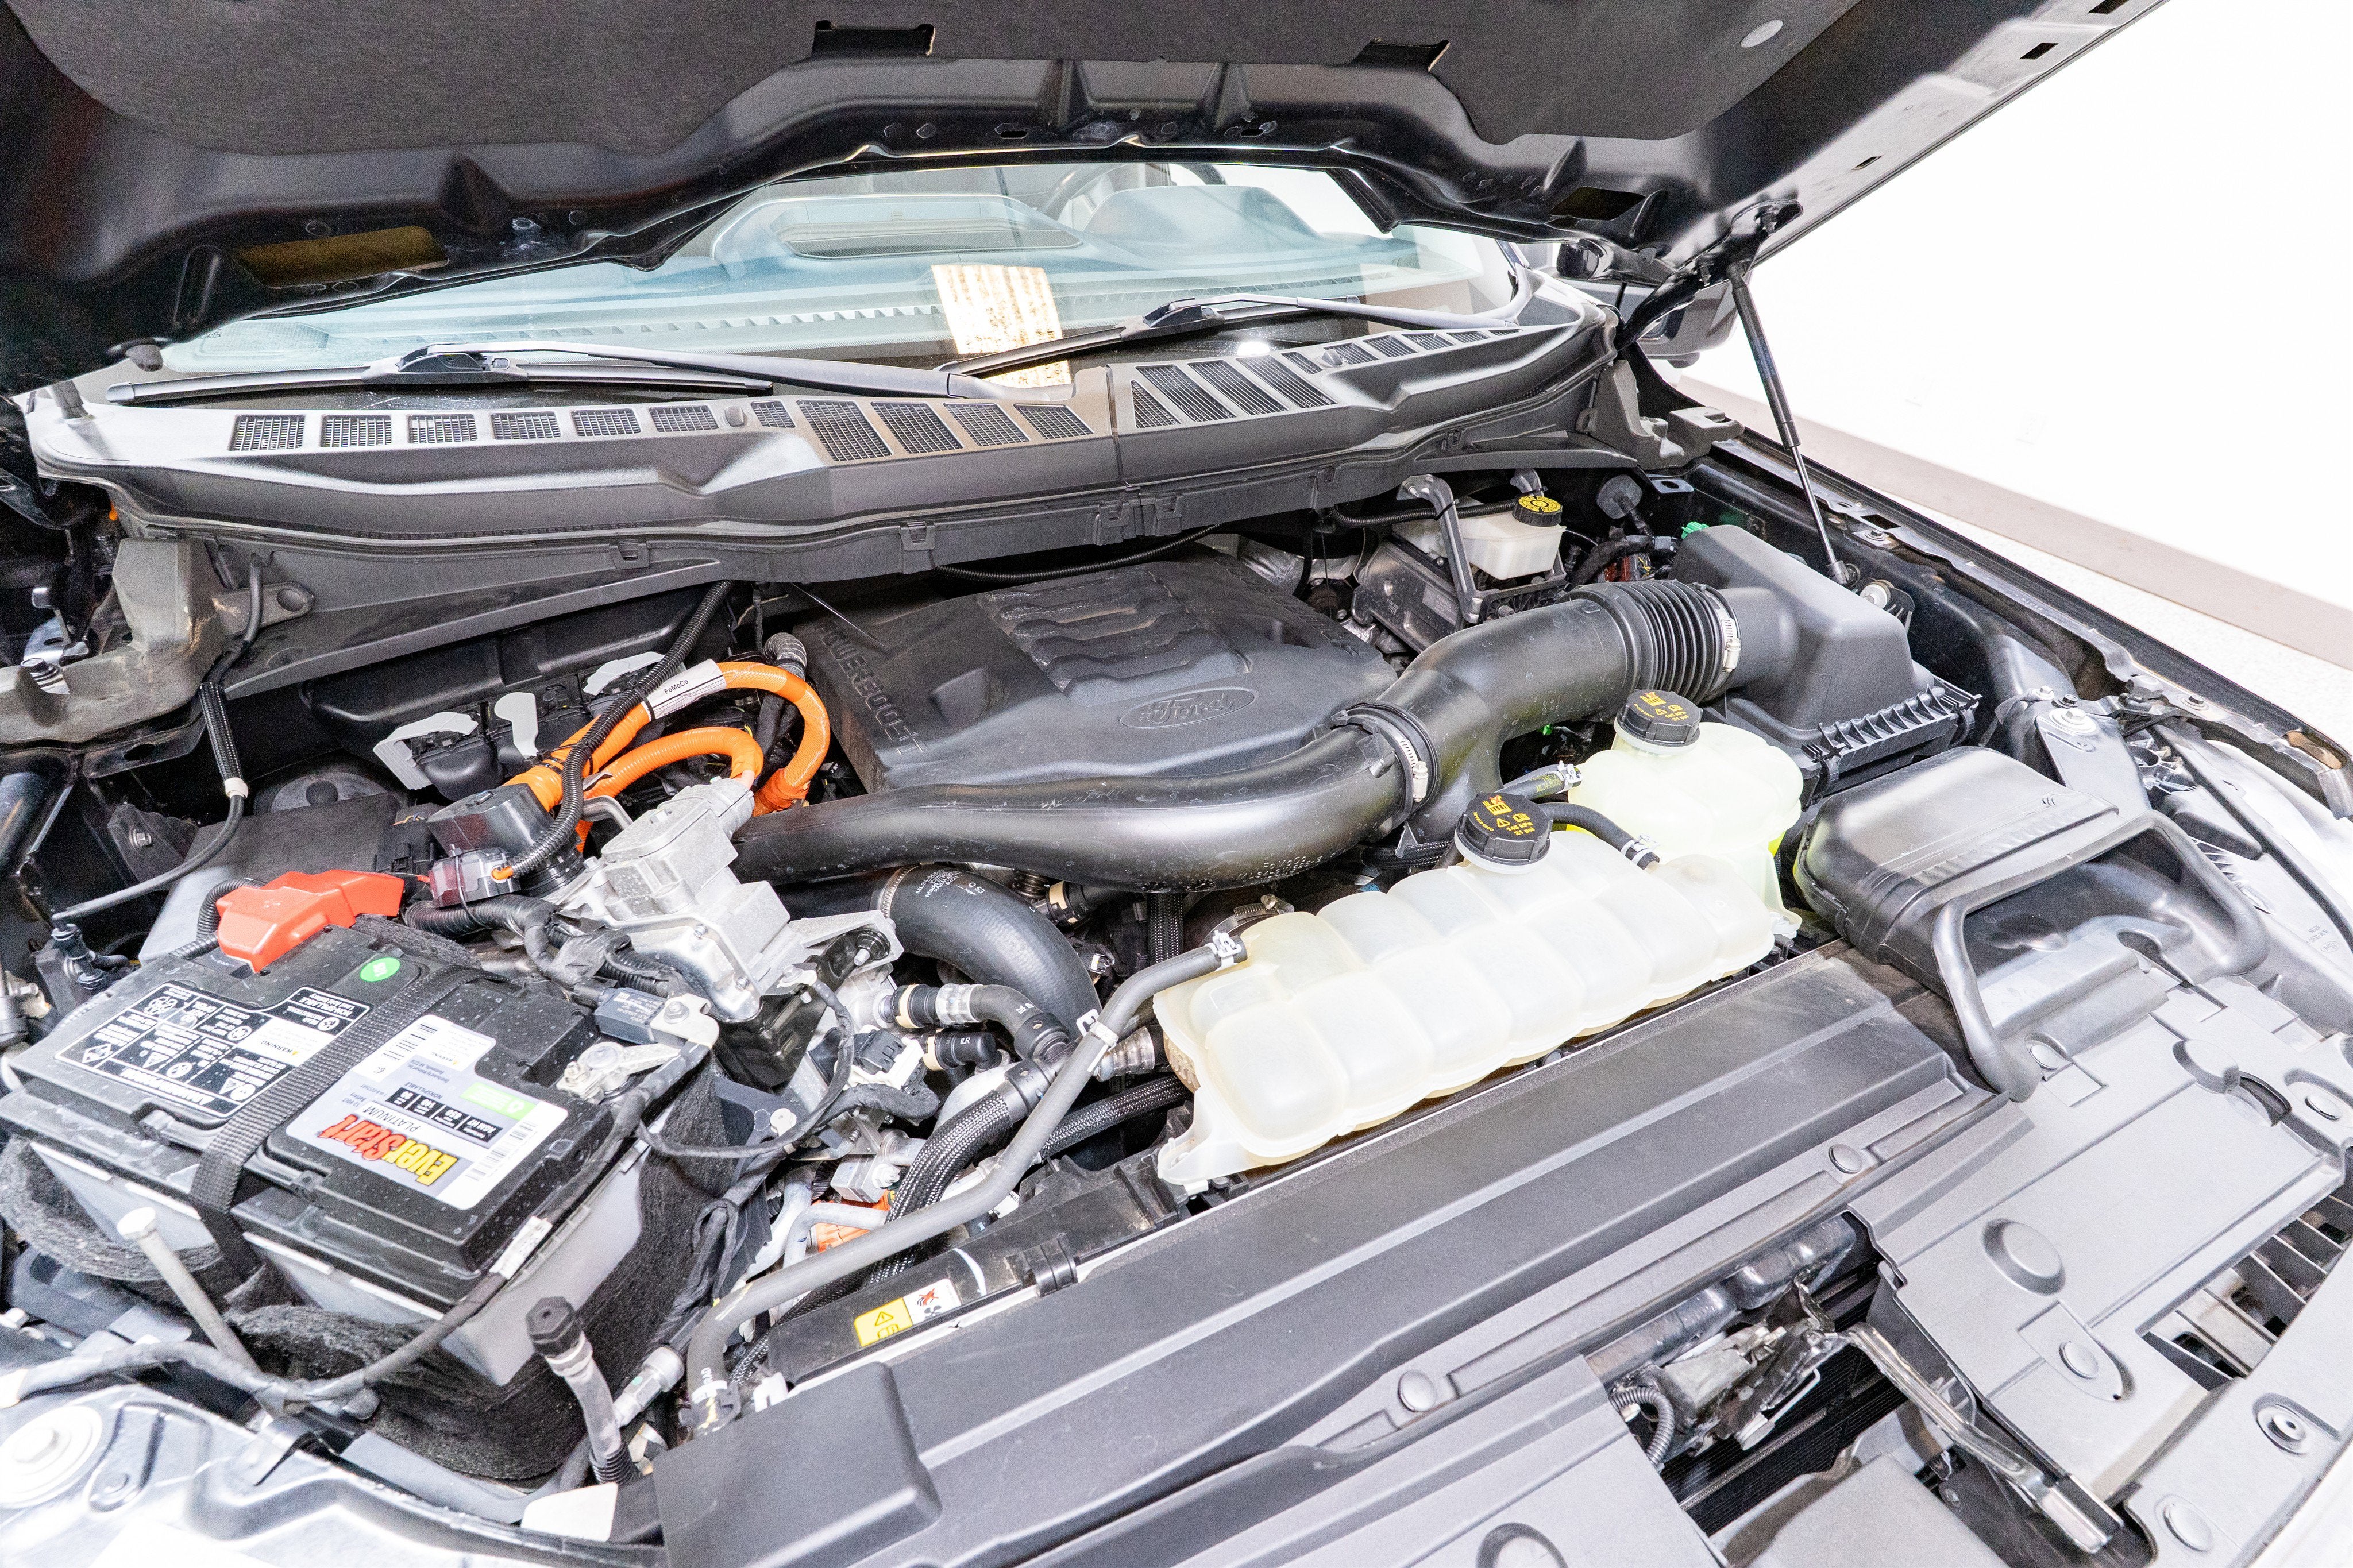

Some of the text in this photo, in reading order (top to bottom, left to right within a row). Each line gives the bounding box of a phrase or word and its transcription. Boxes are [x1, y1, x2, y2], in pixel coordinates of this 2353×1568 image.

[664, 678, 689, 695] FoMoCo
[812, 620, 931, 755] POWERBOOST
[1140, 692, 1237, 725] Ford
[298, 997, 352, 1016] NON-SPILLABLE
[258, 1040, 294, 1053] WARNING
[399, 1090, 414, 1099] 80
[404, 1081, 443, 1099] NONSPILLABLE
[419, 1098, 436, 1109] 140
[361, 1104, 421, 1133] PLATINUM
[443, 1109, 462, 1119] 850
[466, 1118, 496, 1133] AGM H7
[319, 1113, 458, 1187] EverStart
